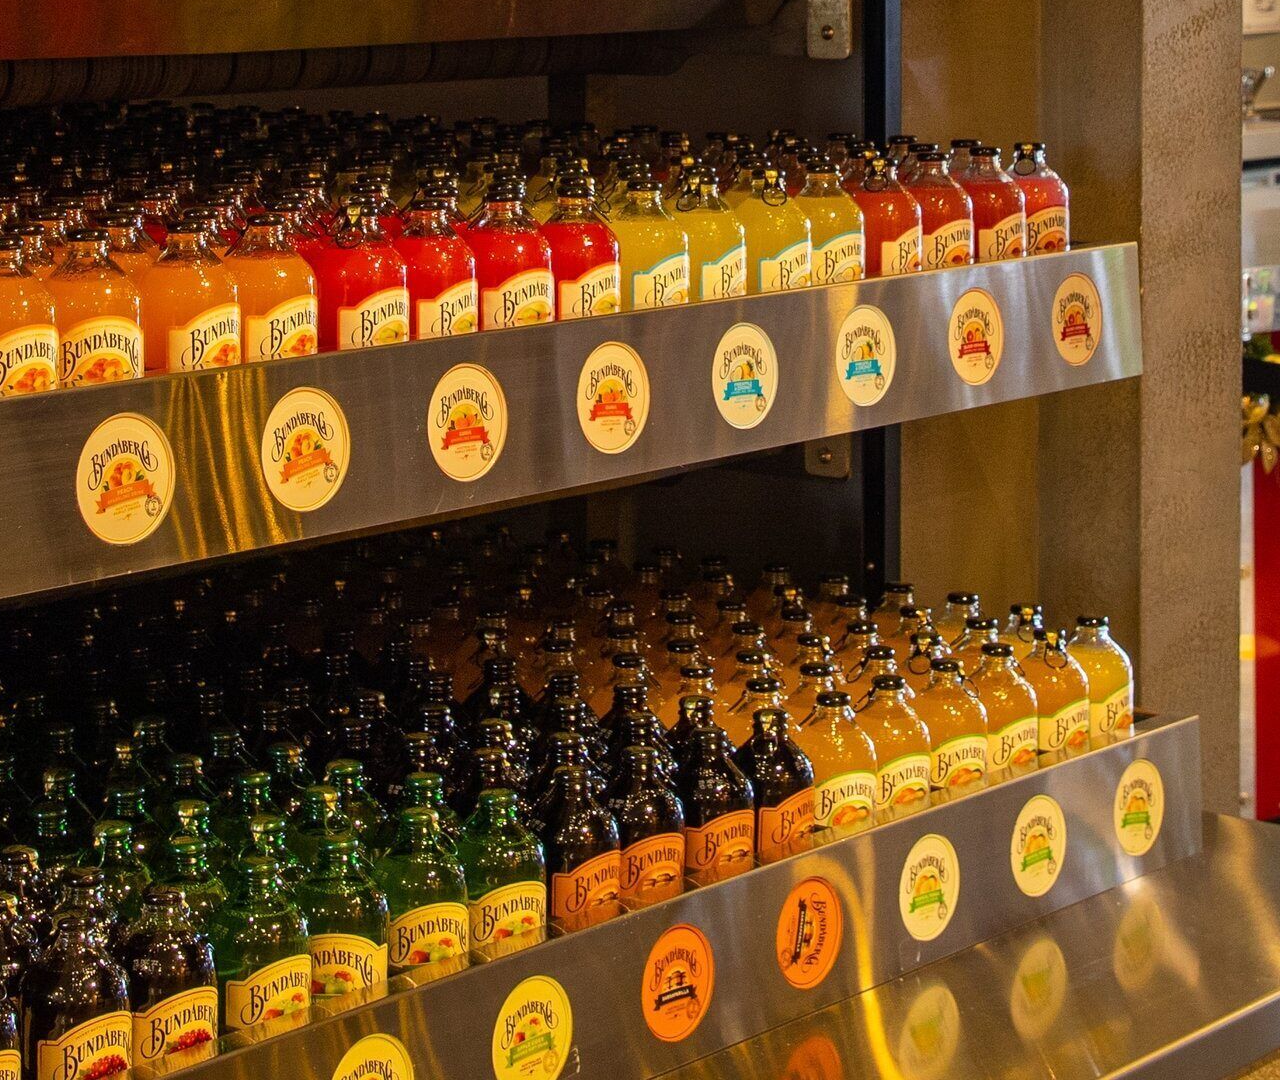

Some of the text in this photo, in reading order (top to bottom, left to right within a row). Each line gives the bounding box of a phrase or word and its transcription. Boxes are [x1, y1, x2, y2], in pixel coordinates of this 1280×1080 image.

[816, 241, 863, 283] BUNDAB
[927, 223, 970, 267] BUNDAB
[351, 298, 409, 346] BUNDAB
[494, 280, 552, 329] BUNDABE
[60, 328, 140, 381] BUNDABERG
[260, 306, 318, 361] BUNDAB
[842, 325, 886, 360] BUNDABERG
[586, 363, 637, 400] BUNDABERG
[720, 342, 767, 380] BUNDABERG
[436, 386, 494, 428] BUNDABERG
[272, 411, 334, 463] BUNDABERG
[88, 438, 158, 491] BUNDABERG
[815, 784, 874, 820] BUNDABER
[877, 766, 930, 808] BUNDABE
[696, 820, 755, 866] BUNDABE
[566, 856, 619, 912] BUNDAB
[621, 846, 682, 891] BUNDABE
[390, 919, 468, 964] BUNDABERG
[313, 946, 375, 986] NDABERG
[241, 965, 311, 1026] BUNDABER
[501, 1001, 558, 1050] BUNDABERG
